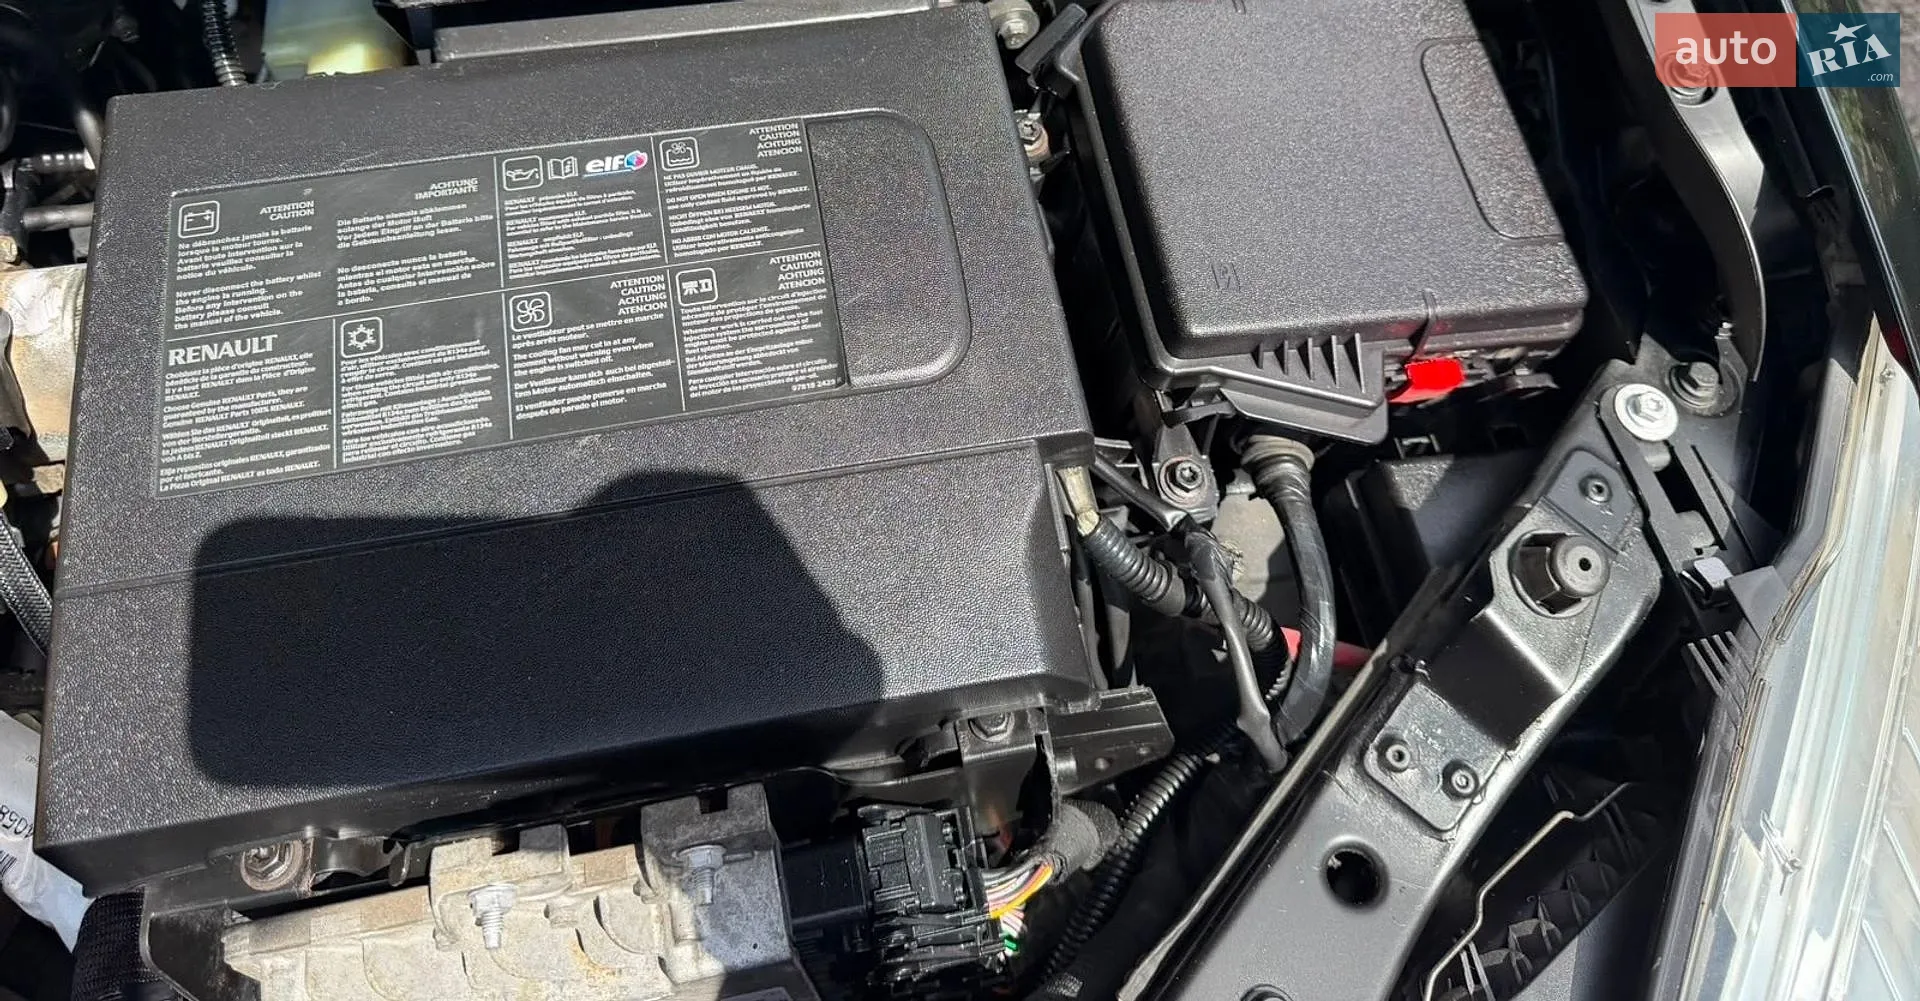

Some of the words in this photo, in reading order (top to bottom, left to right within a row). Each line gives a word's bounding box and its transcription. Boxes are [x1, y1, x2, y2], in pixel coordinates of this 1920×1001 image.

[748, 122, 798, 135] ATTENTION
[758, 130, 799, 141] CAUTION
[756, 137, 801, 149] ACHTUNG
[585, 154, 625, 173] elf
[430, 177, 478, 190] ACHTUNG
[415, 184, 478, 200] IMPORTANTE
[259, 200, 314, 214] ATTENTION
[269, 208, 314, 221] CAUTION
[769, 250, 821, 264] ATTENTION
[780, 258, 822, 272] CAUTION
[610, 274, 664, 288] ATTENTION
[777, 267, 824, 281] ACHTUNG
[620, 283, 665, 296] CAUTION
[618, 291, 666, 306] ACHTUNG
[617, 301, 667, 315] ATENCION
[167, 334, 278, 366] RENAULT
[572, 343, 588, 352] may
[622, 336, 636, 344] any
[612, 345, 631, 353] even
[632, 341, 653, 349] when
